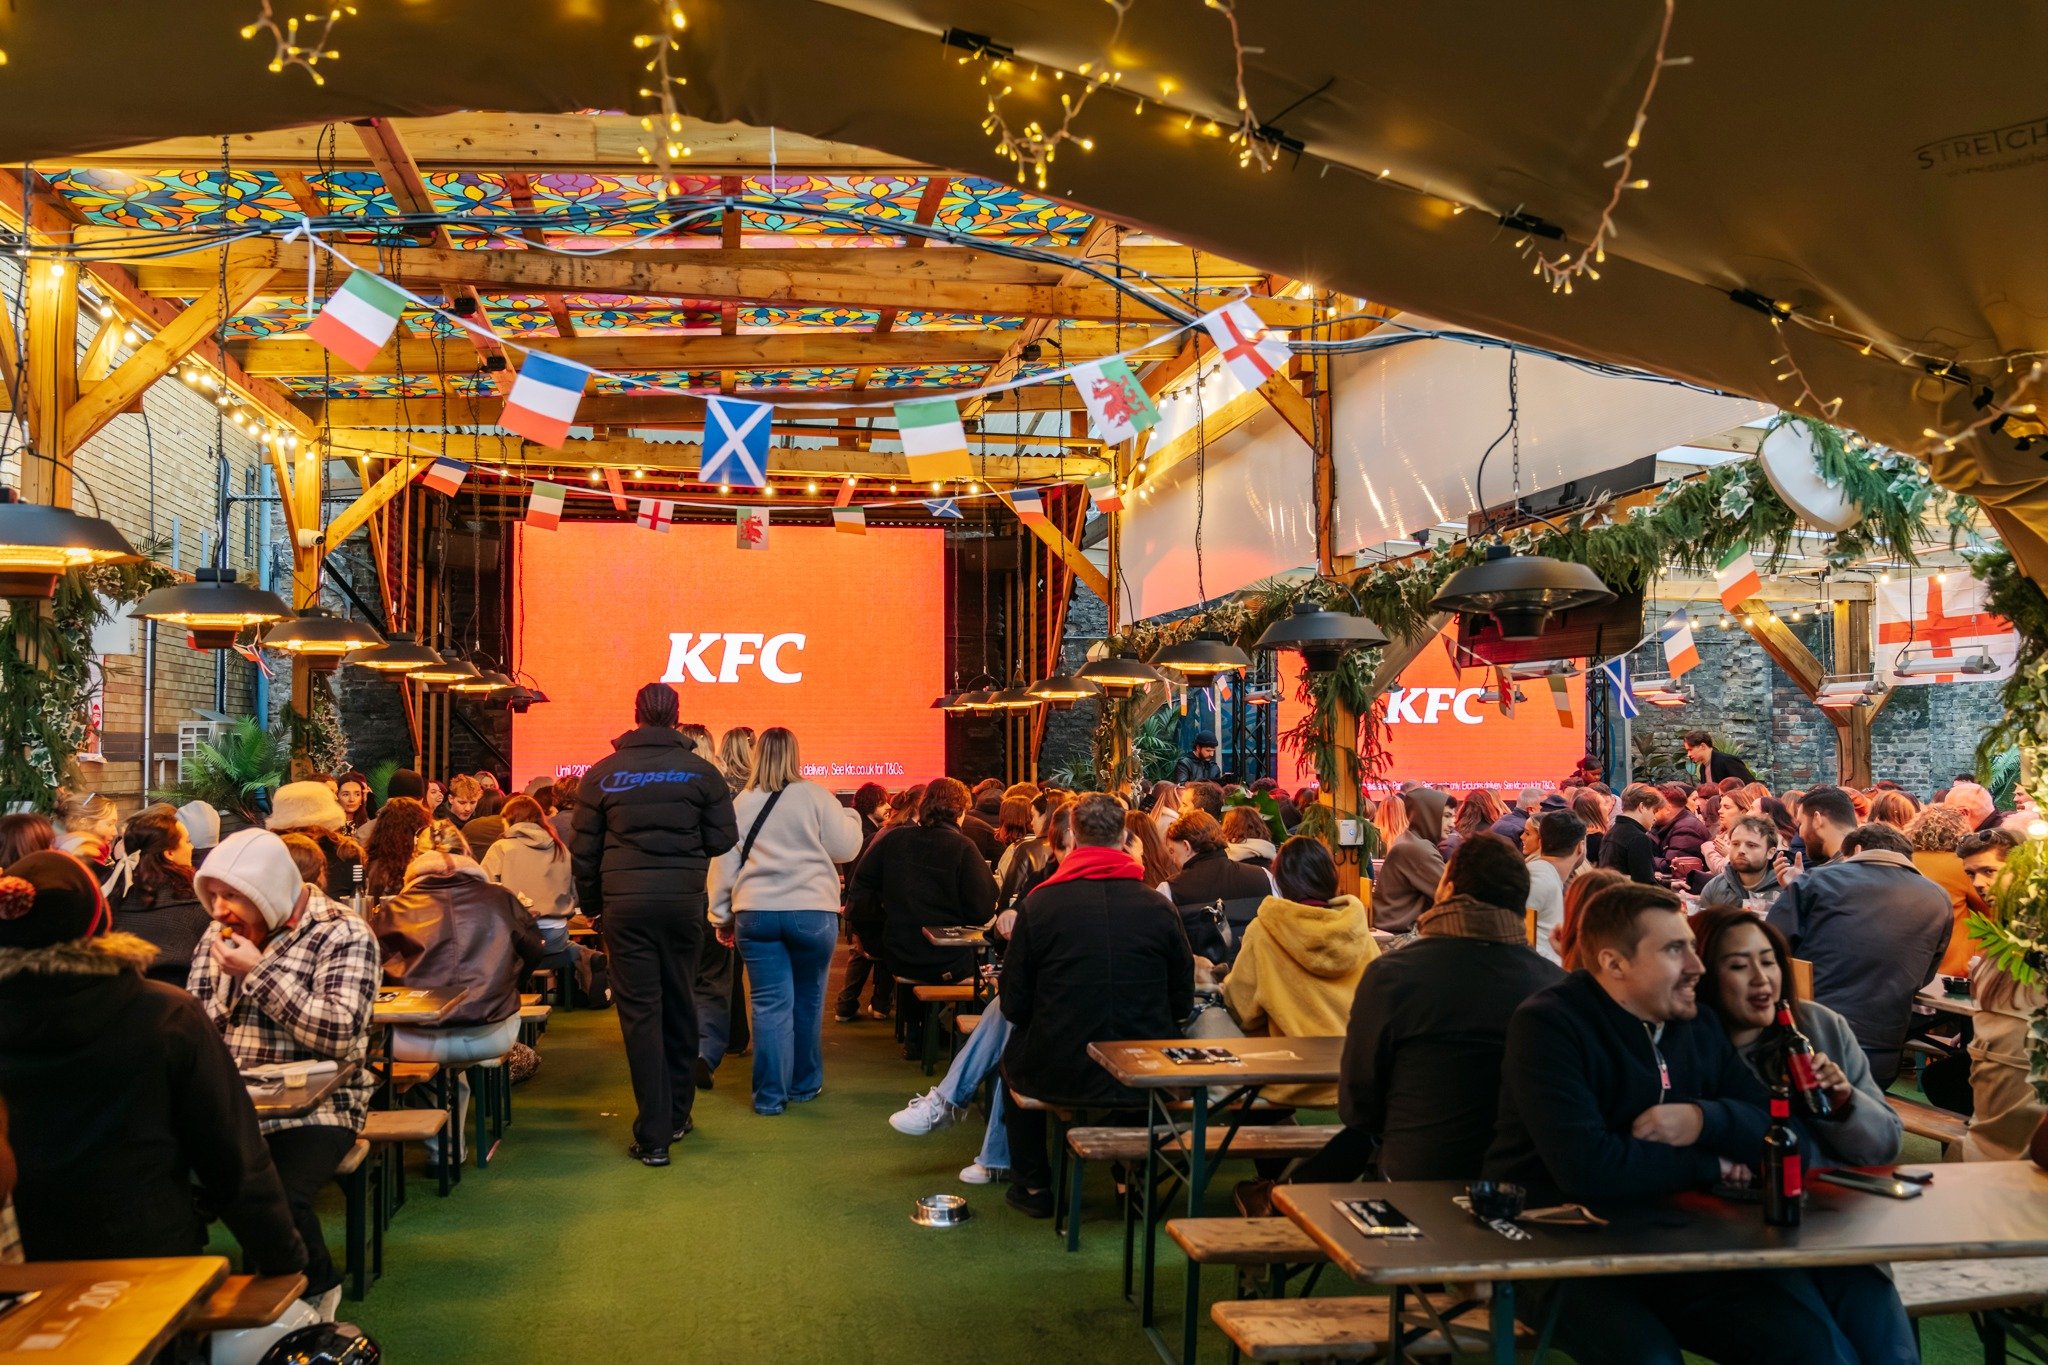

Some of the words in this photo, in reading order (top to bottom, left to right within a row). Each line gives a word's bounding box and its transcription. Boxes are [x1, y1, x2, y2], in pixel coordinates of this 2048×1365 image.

[659, 632, 806, 683] KFC
[1383, 687, 1485, 724] KFC
[603, 769, 700, 790] Trapstar
[803, 763, 829, 778] delivery.
[831, 763, 845, 776] See
[845, 763, 874, 776] kfc.co.uk
[875, 763, 884, 776] for
[884, 763, 905, 776] T&Cs.
